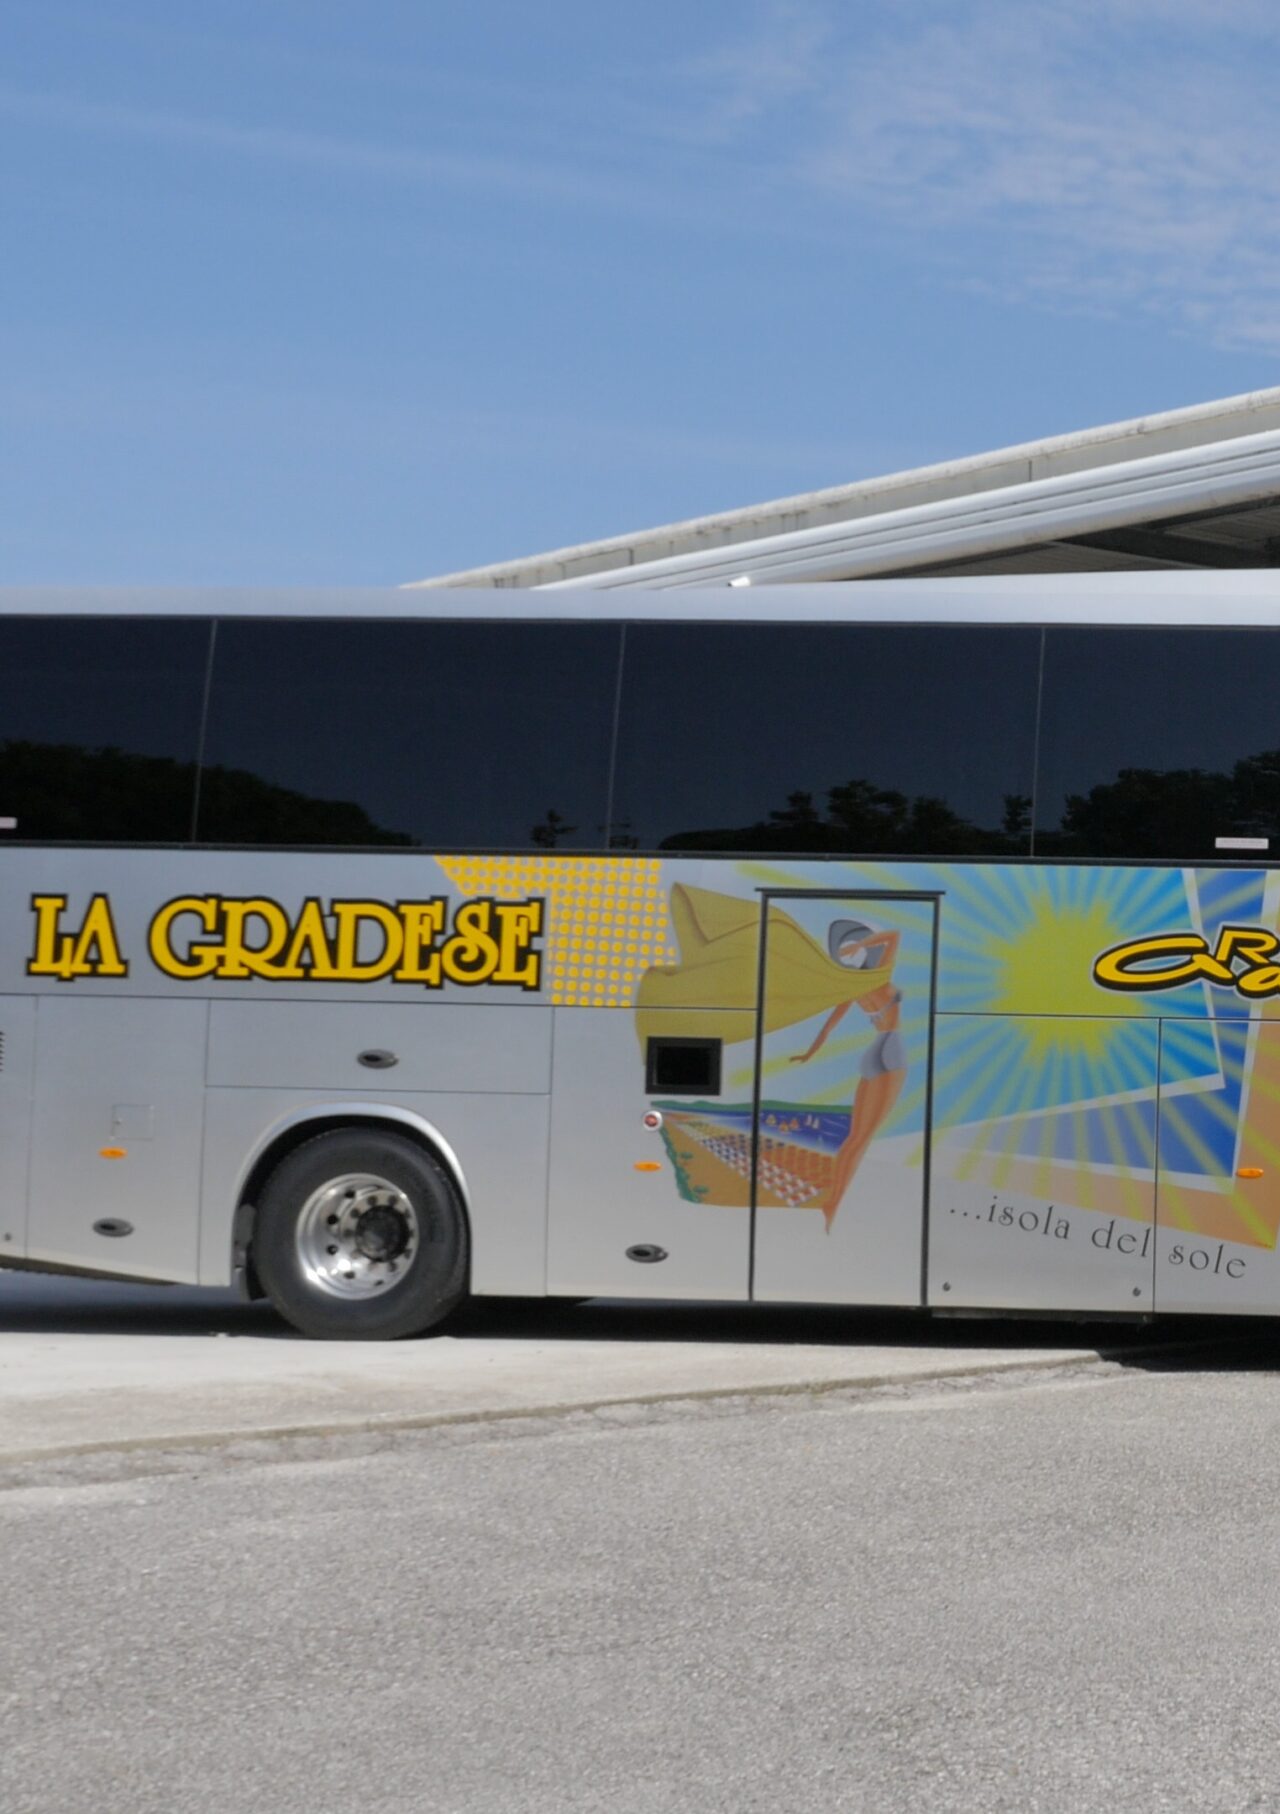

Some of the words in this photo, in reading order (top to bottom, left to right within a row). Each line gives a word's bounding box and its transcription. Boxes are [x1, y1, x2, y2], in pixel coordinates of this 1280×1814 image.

[26, 893, 129, 982] LA
[146, 893, 546, 991] GRADESE
[1091, 1219, 1151, 1258] del
[1167, 1243, 1247, 1280] sole
